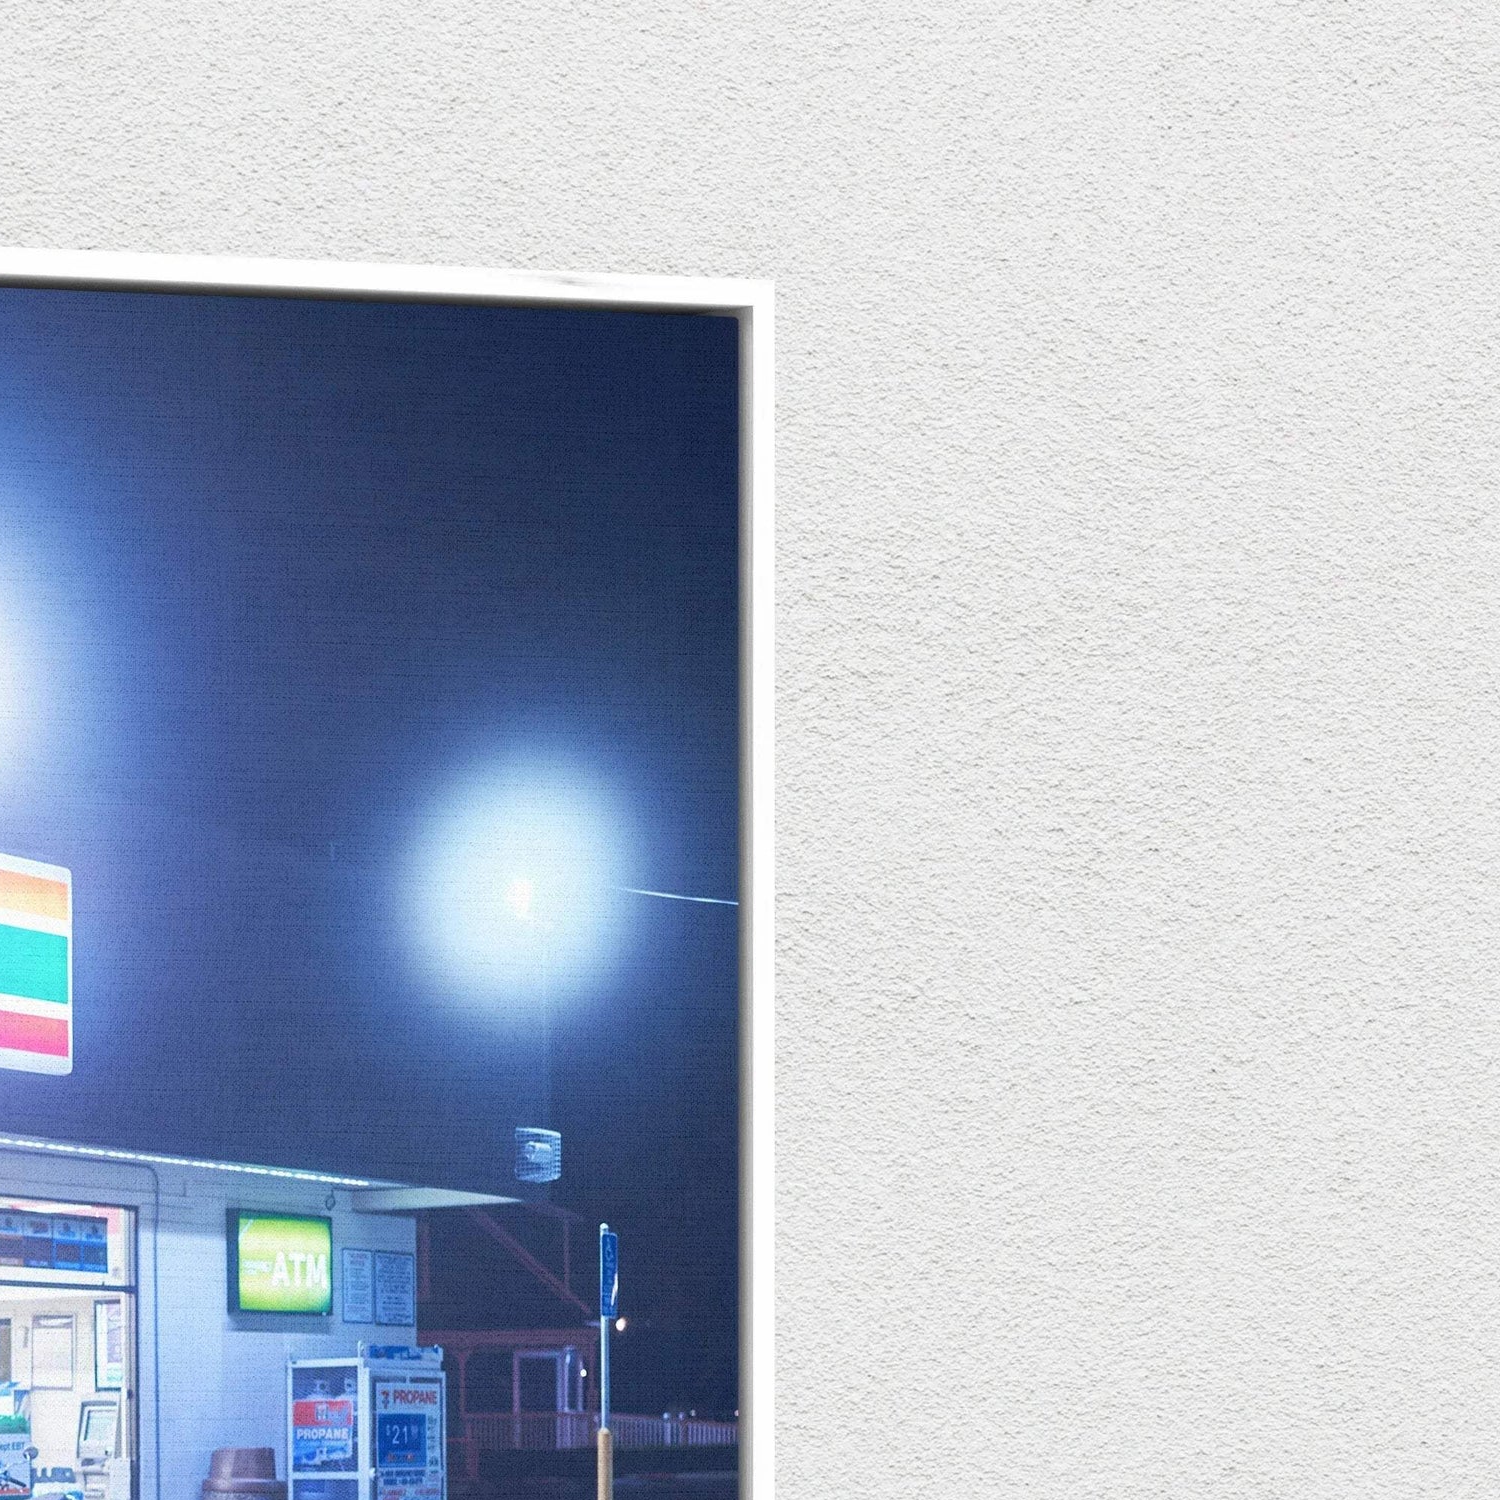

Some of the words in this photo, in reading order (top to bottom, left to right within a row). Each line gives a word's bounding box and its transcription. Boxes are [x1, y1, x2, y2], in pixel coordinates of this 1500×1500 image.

[270, 1250, 328, 1290] ATM
[393, 1389, 438, 1405] PROPANE
[296, 1428, 349, 1441] PROPANE
[12, 1442, 25, 1451] EBT
